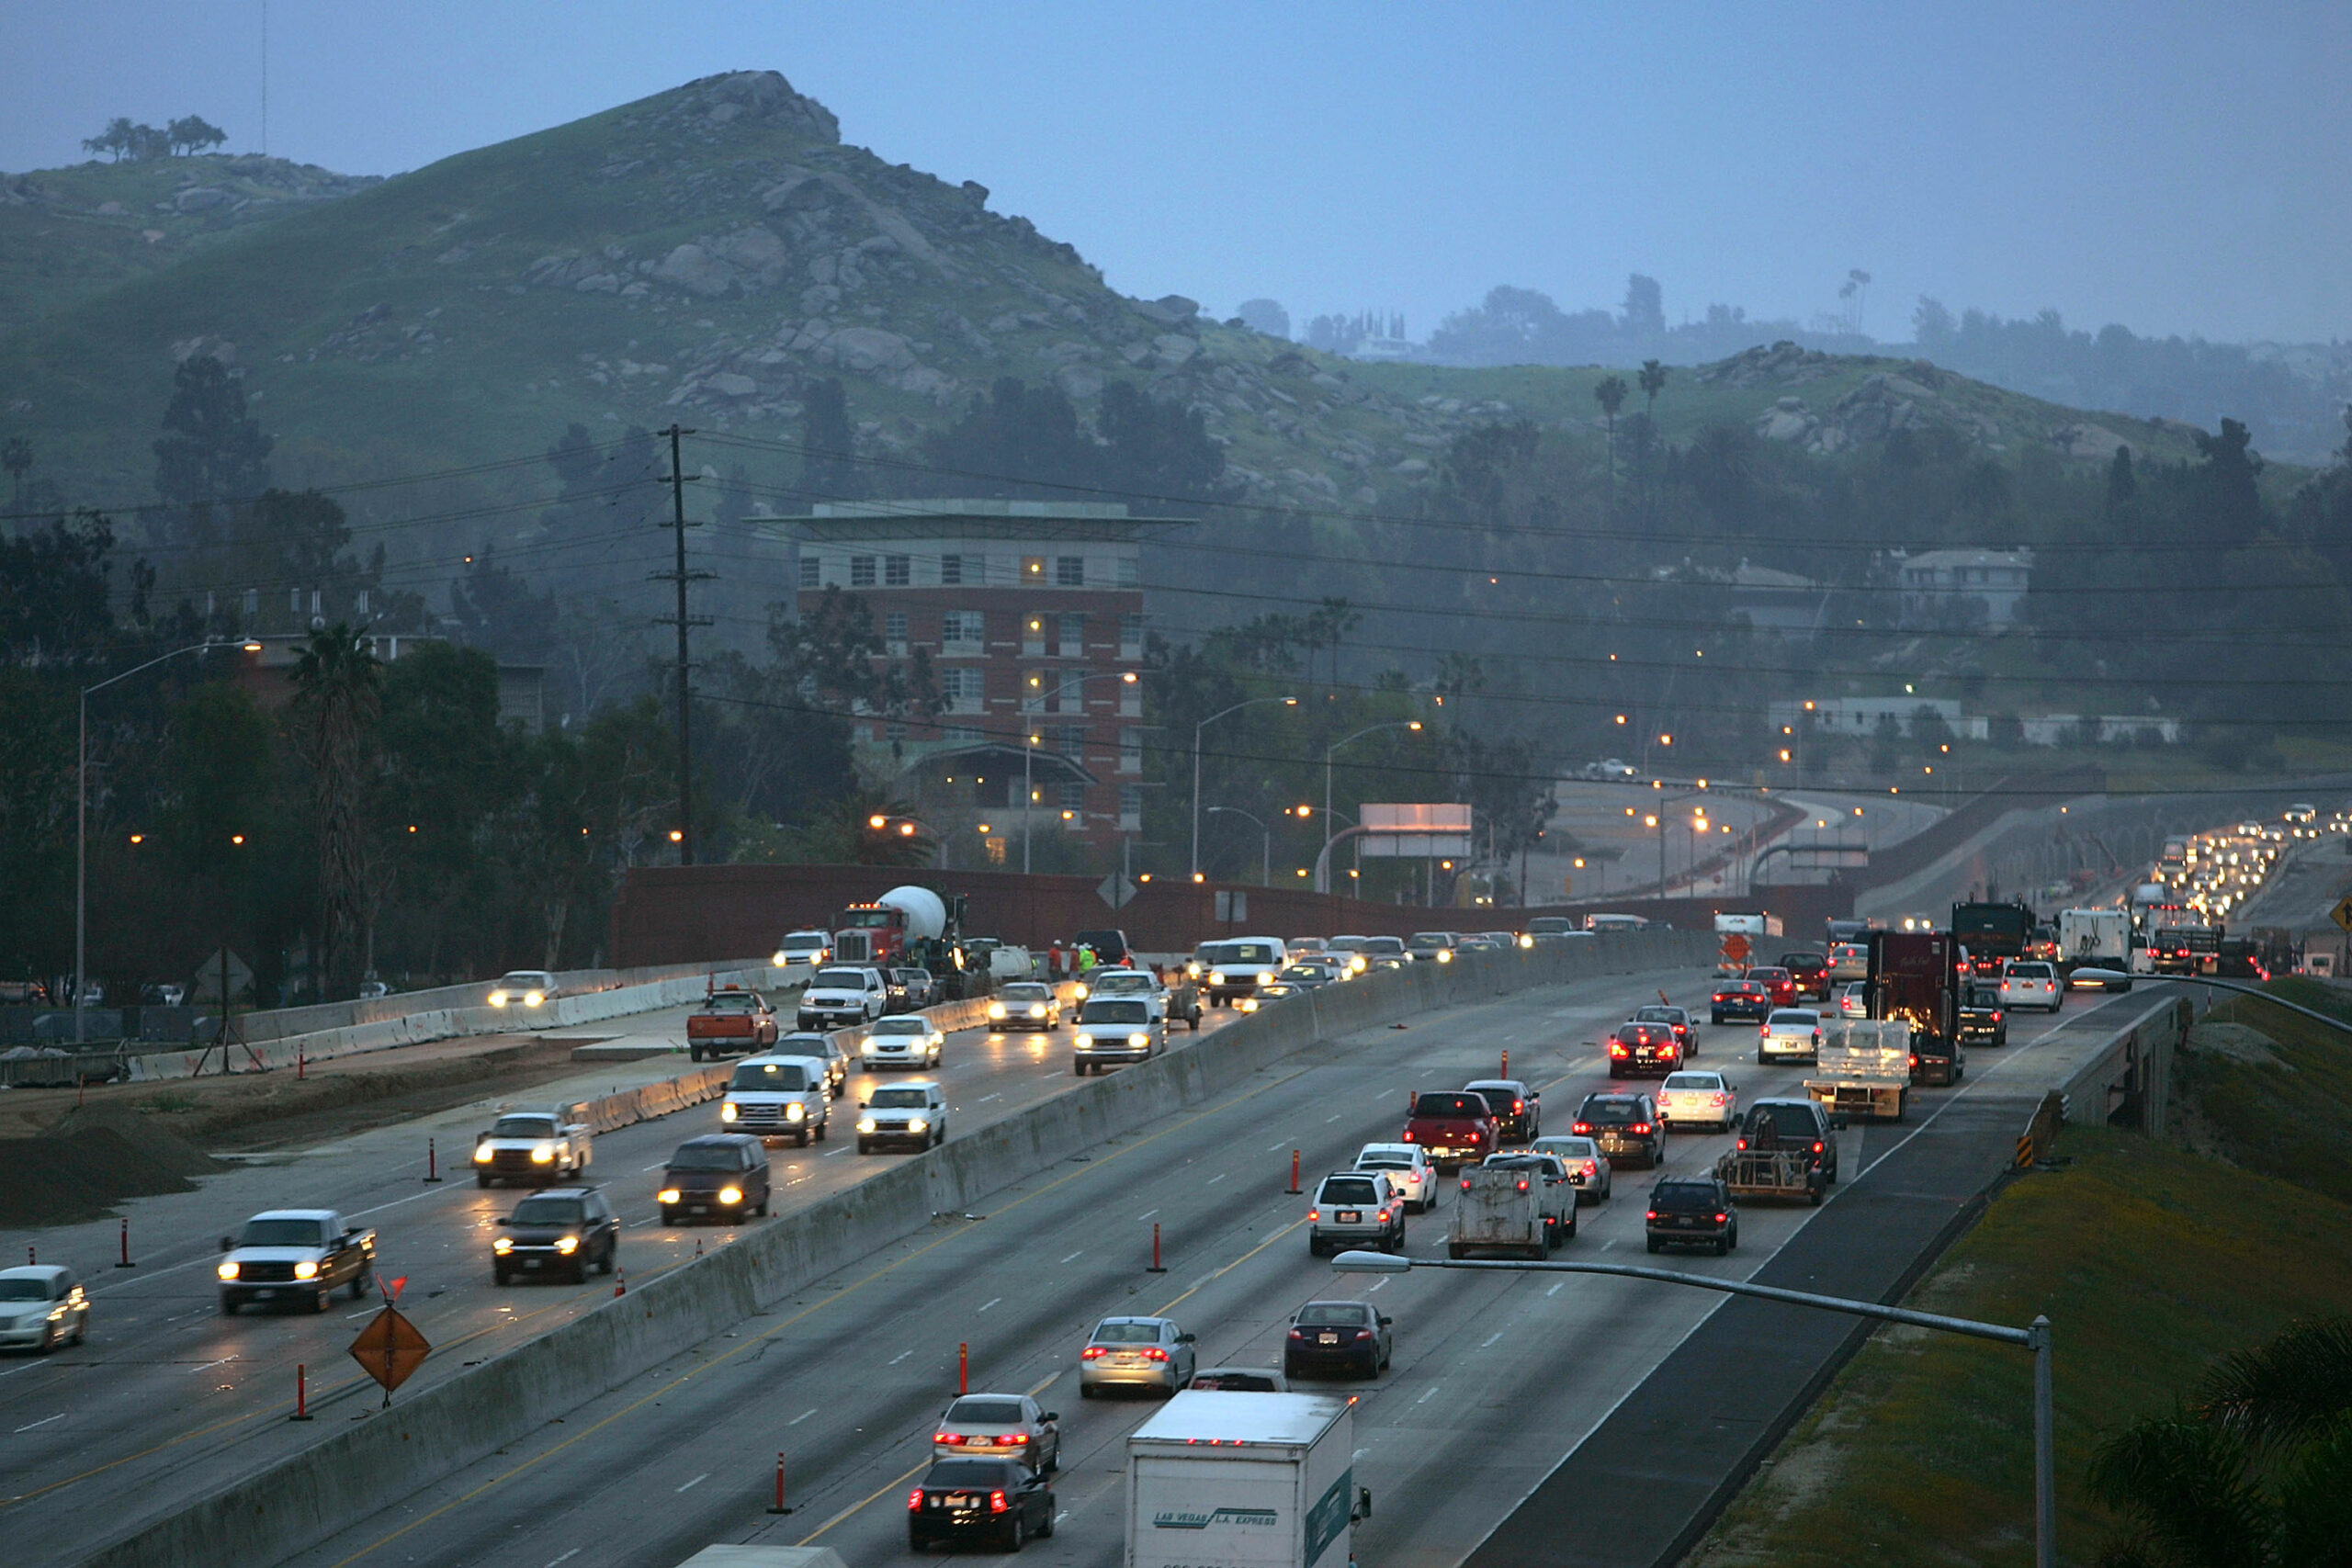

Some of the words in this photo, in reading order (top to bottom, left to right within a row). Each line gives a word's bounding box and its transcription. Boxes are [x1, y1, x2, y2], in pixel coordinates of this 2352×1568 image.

[1155, 1512, 1172, 1520] LAS
[1177, 1513, 1208, 1522] VEGAS
[1235, 1516, 1277, 1526] EXPRESS
